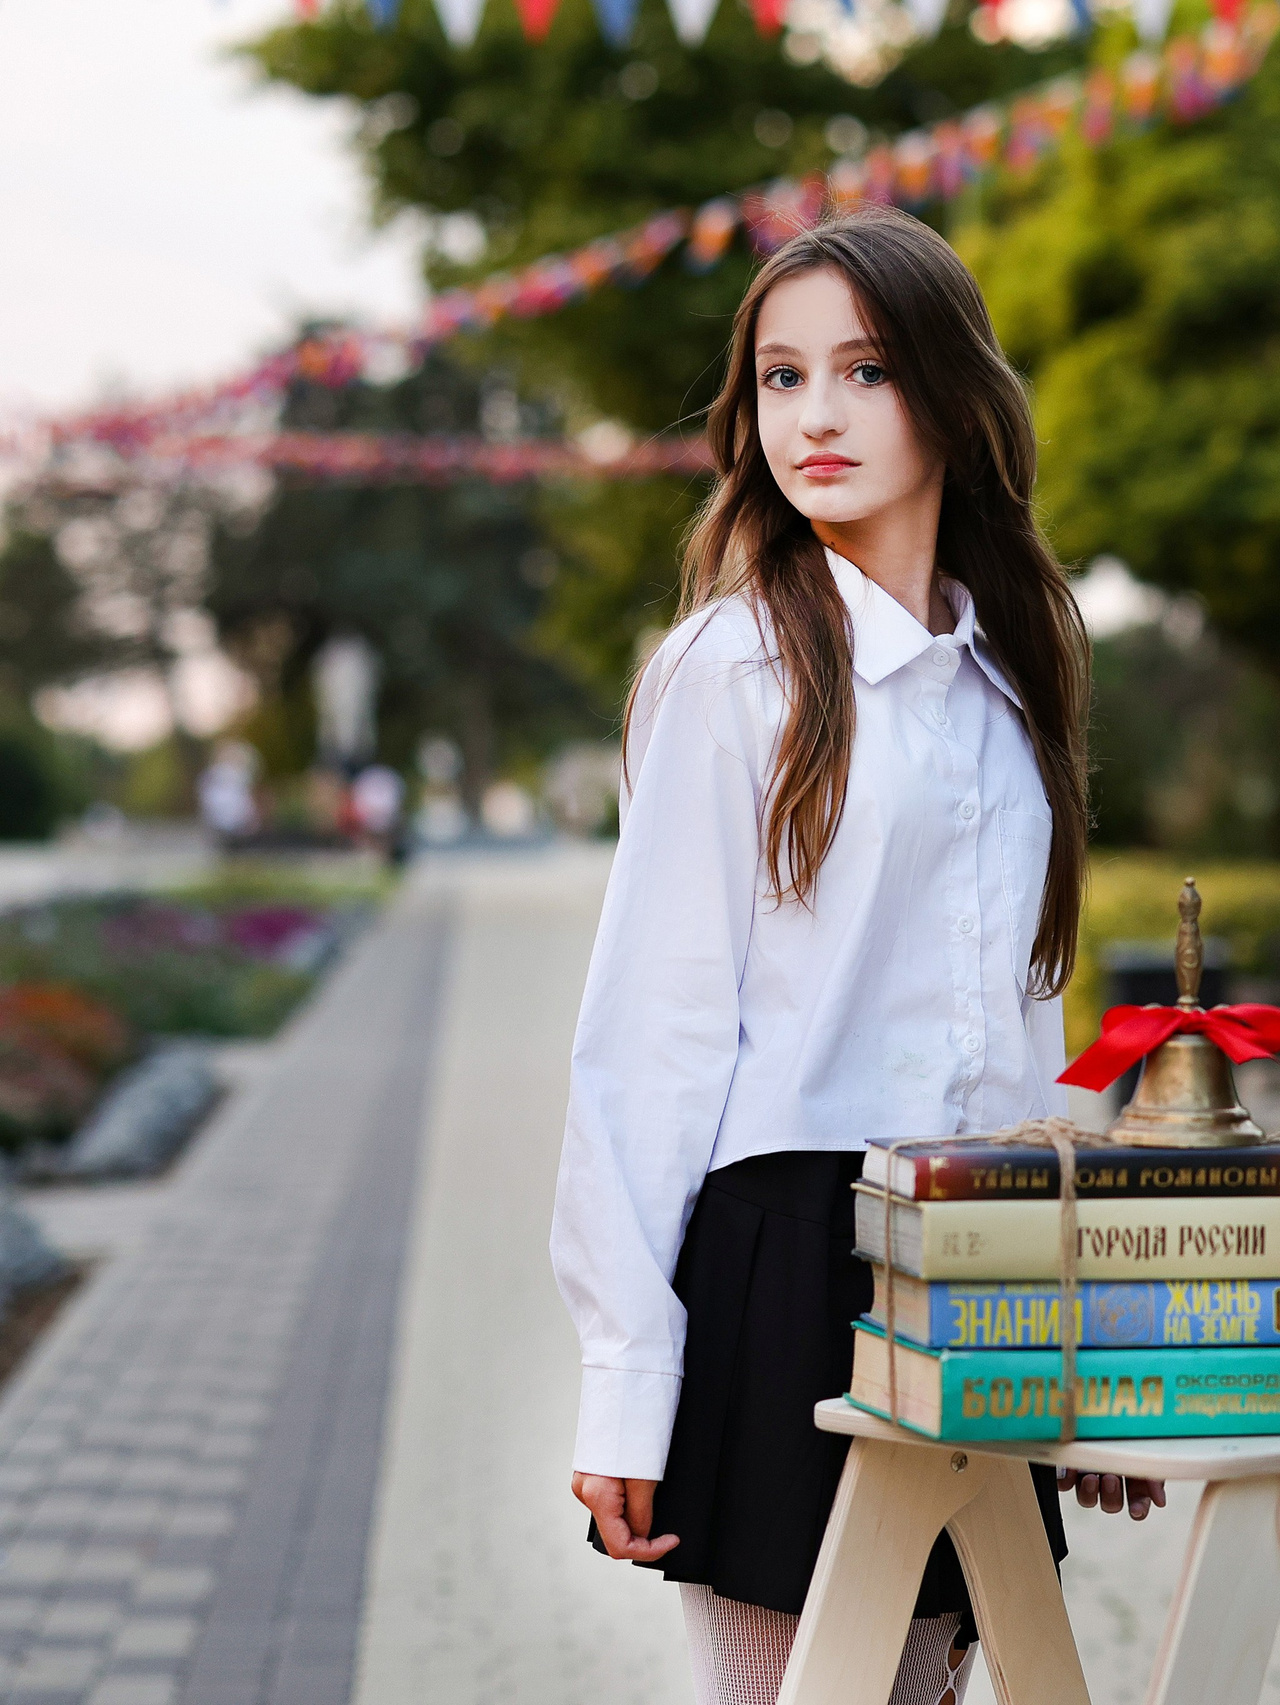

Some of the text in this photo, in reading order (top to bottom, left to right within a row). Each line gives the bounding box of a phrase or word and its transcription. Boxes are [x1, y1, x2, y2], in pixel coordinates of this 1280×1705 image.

[970, 1162, 1049, 1189] ТАЙНЫ
[1072, 1166, 1129, 1188] ОМА
[1076, 1224, 1266, 1261] ГОРОДА РОССИИ
[1164, 1279, 1262, 1315] ЖИЗНЬ
[1163, 1315, 1192, 1344] НА
[961, 1375, 1164, 1418] БОЛЬШАЯ
